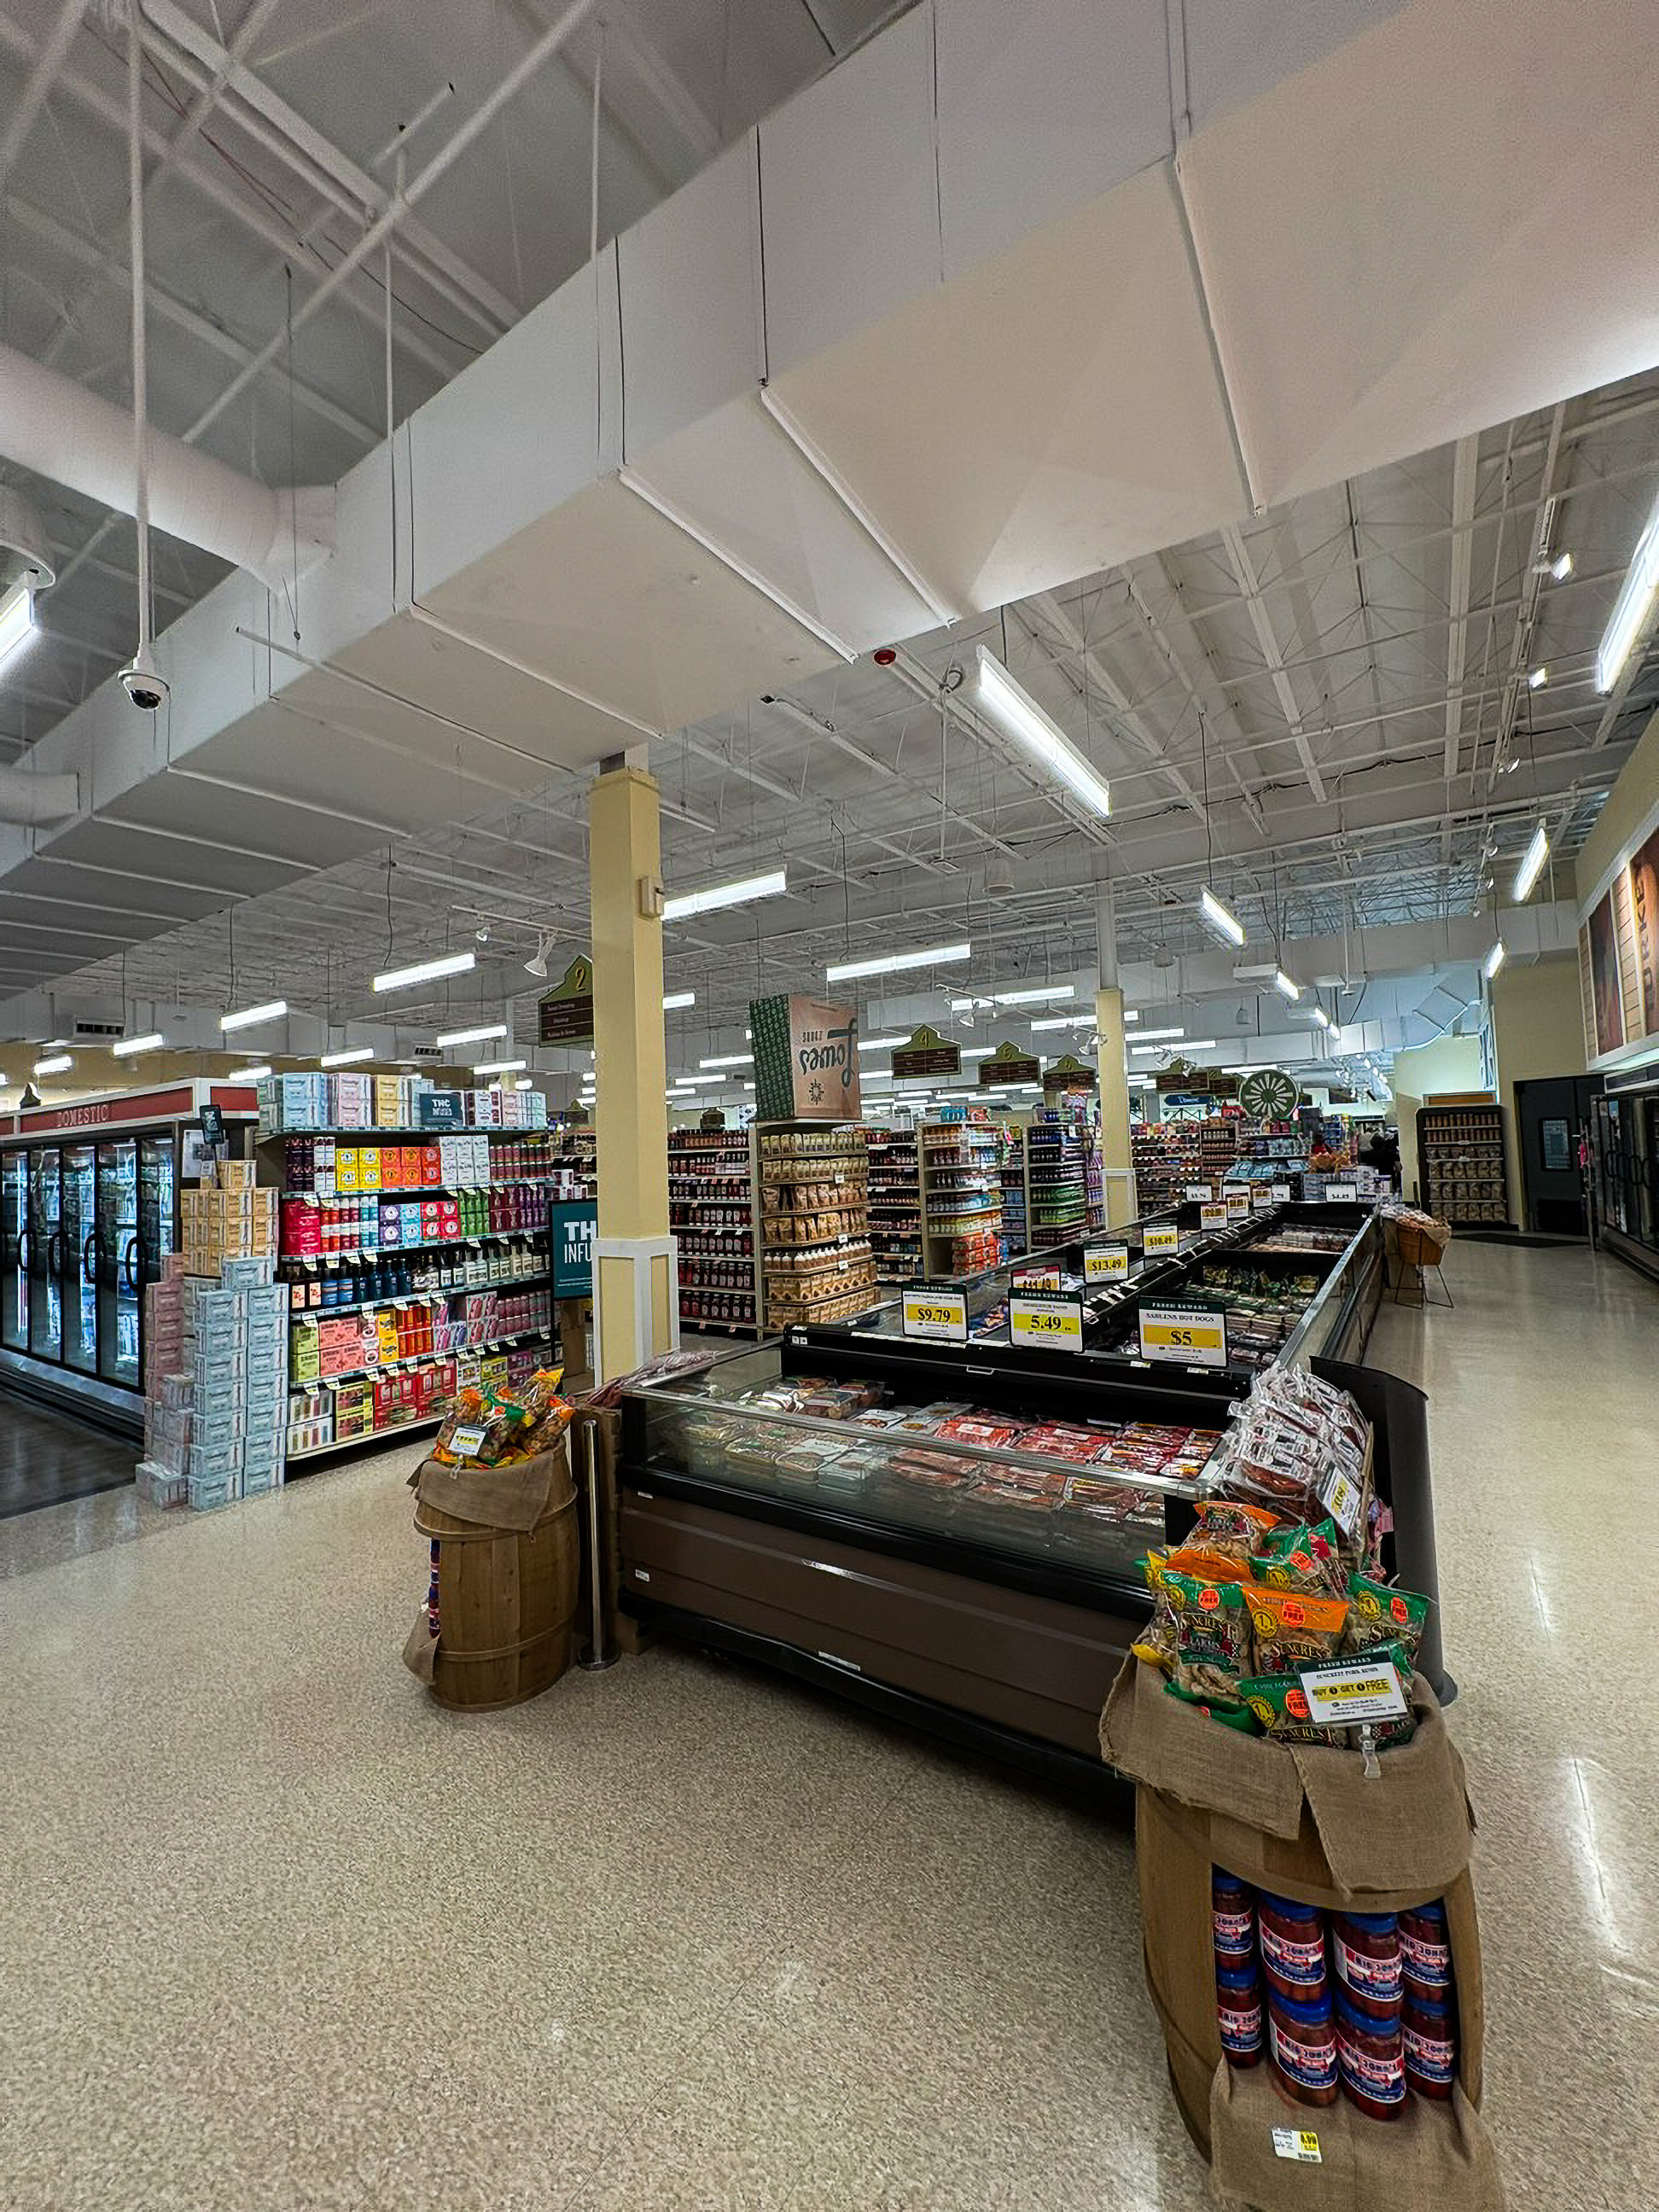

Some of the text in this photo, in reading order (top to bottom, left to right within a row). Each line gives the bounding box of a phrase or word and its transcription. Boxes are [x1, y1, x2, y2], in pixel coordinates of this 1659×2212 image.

[575, 966, 586, 992] 2
[920, 1030, 929, 1048] 4
[564, 1220, 597, 1241] TH
[564, 1243, 593, 1263] INFU
[917, 1307, 951, 1323] $9.79
[1030, 1314, 1062, 1330] 5.49
[1170, 1330, 1192, 1346] $5
[1341, 1684, 1355, 1693] GET
[1365, 1679, 1388, 1691] FREE
